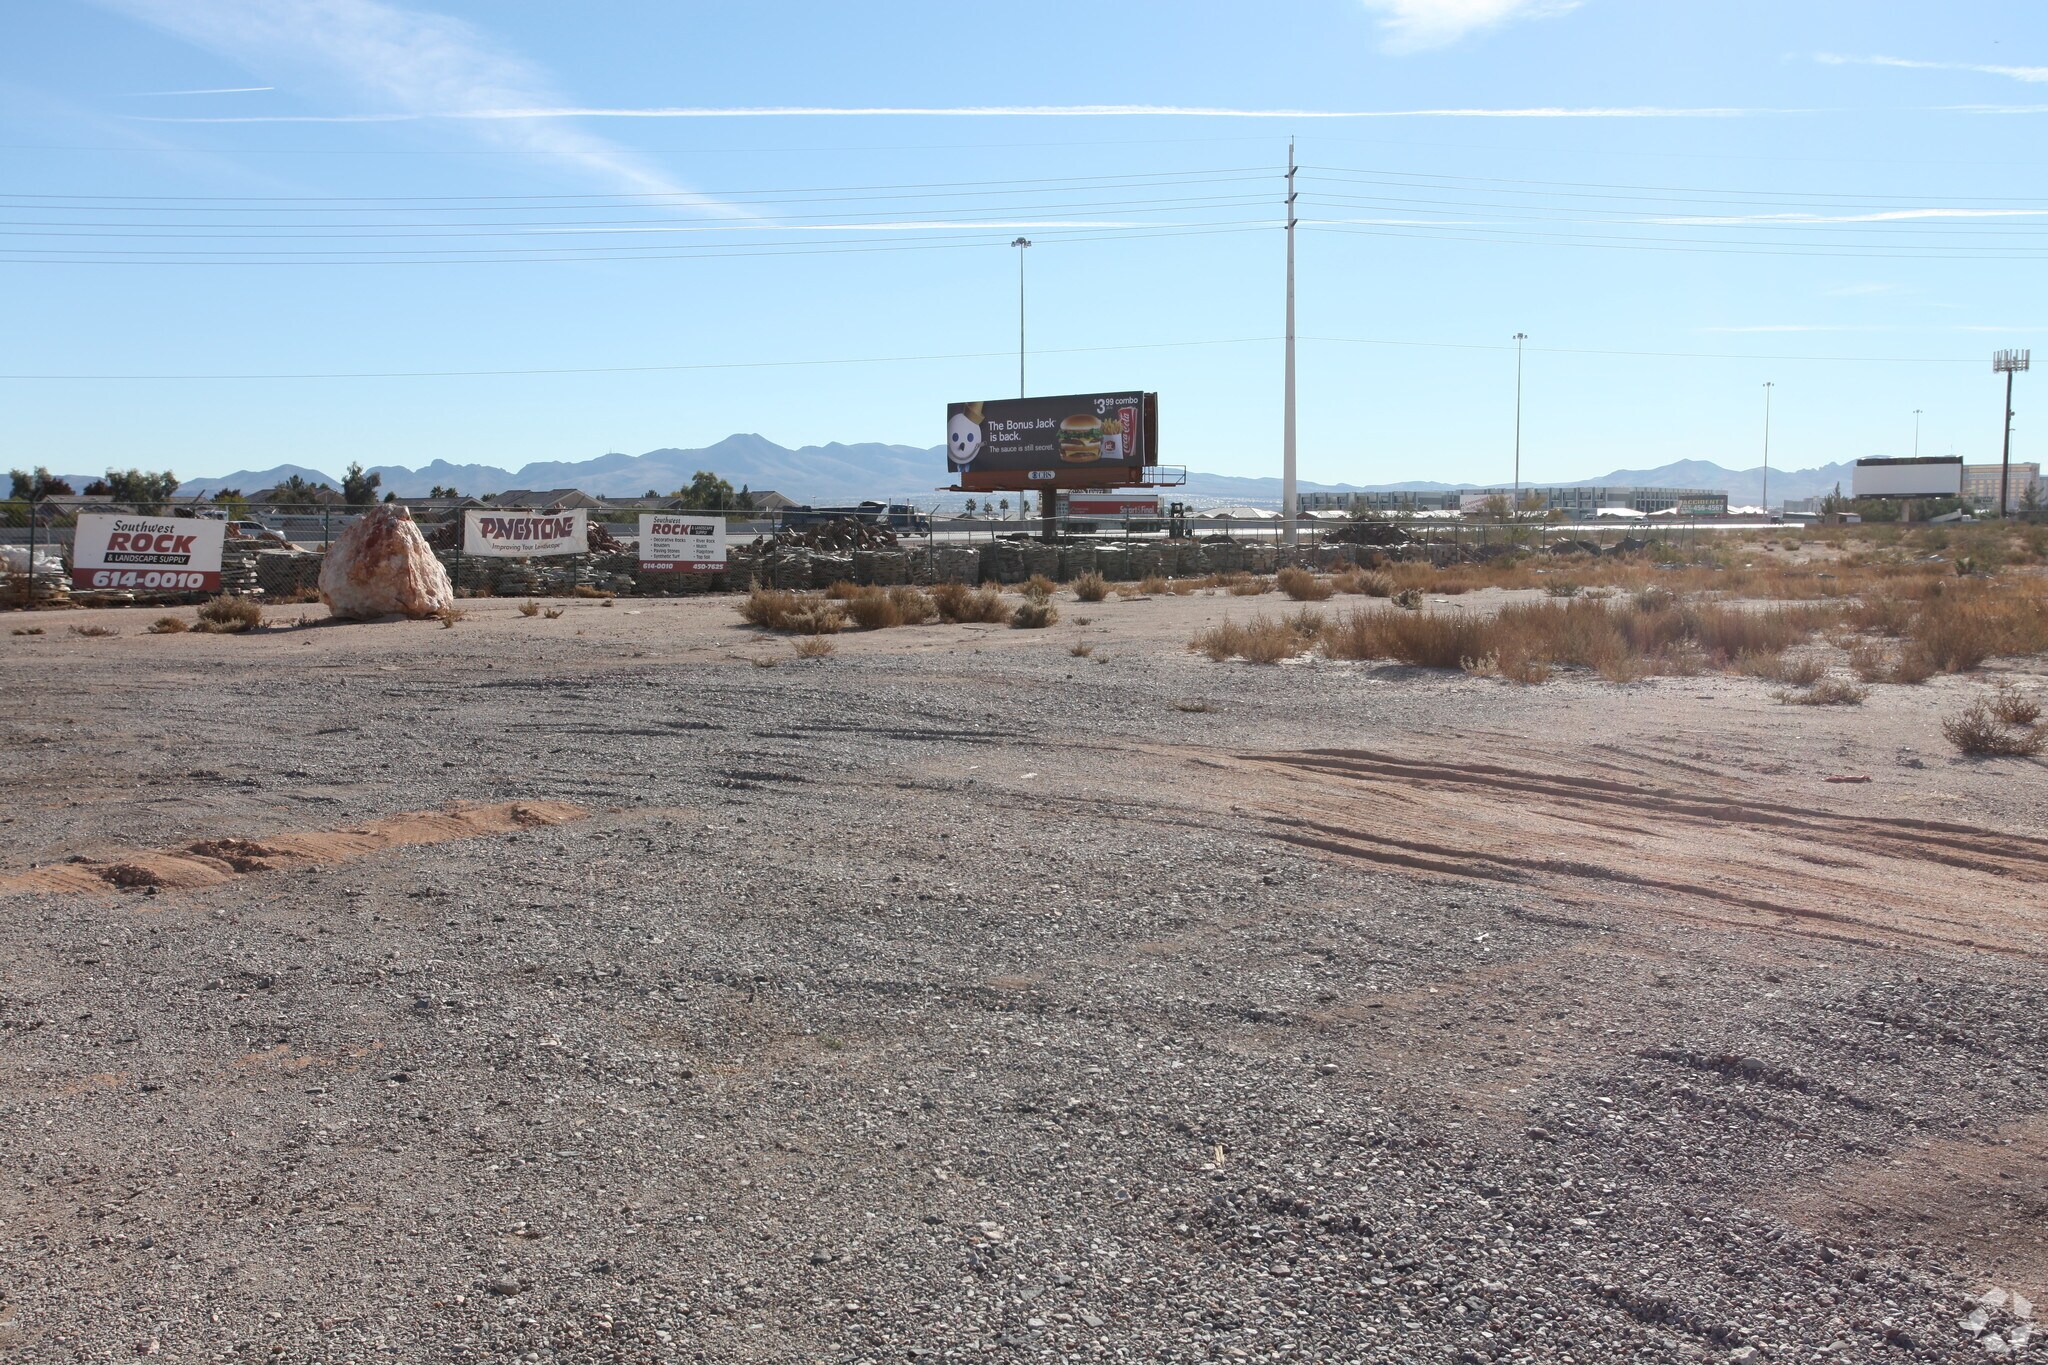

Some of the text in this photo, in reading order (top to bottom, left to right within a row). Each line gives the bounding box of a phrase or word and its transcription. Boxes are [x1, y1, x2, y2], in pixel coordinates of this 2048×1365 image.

[1115, 396, 1139, 405] combo
[988, 418, 1055, 431] The Bonus Jack
[989, 431, 1021, 442] is back.
[1024, 444, 1034, 452] still
[1141, 505, 1155, 514] Final
[653, 516, 681, 524] Southwest
[113, 520, 175, 533] Southwest
[651, 523, 691, 536] ROCK
[107, 533, 197, 553] ROCK
[492, 543, 520, 552] Improving
[107, 553, 187, 564] & LANDSCAPE SUPPLY
[92, 571, 205, 589] 614-0010
